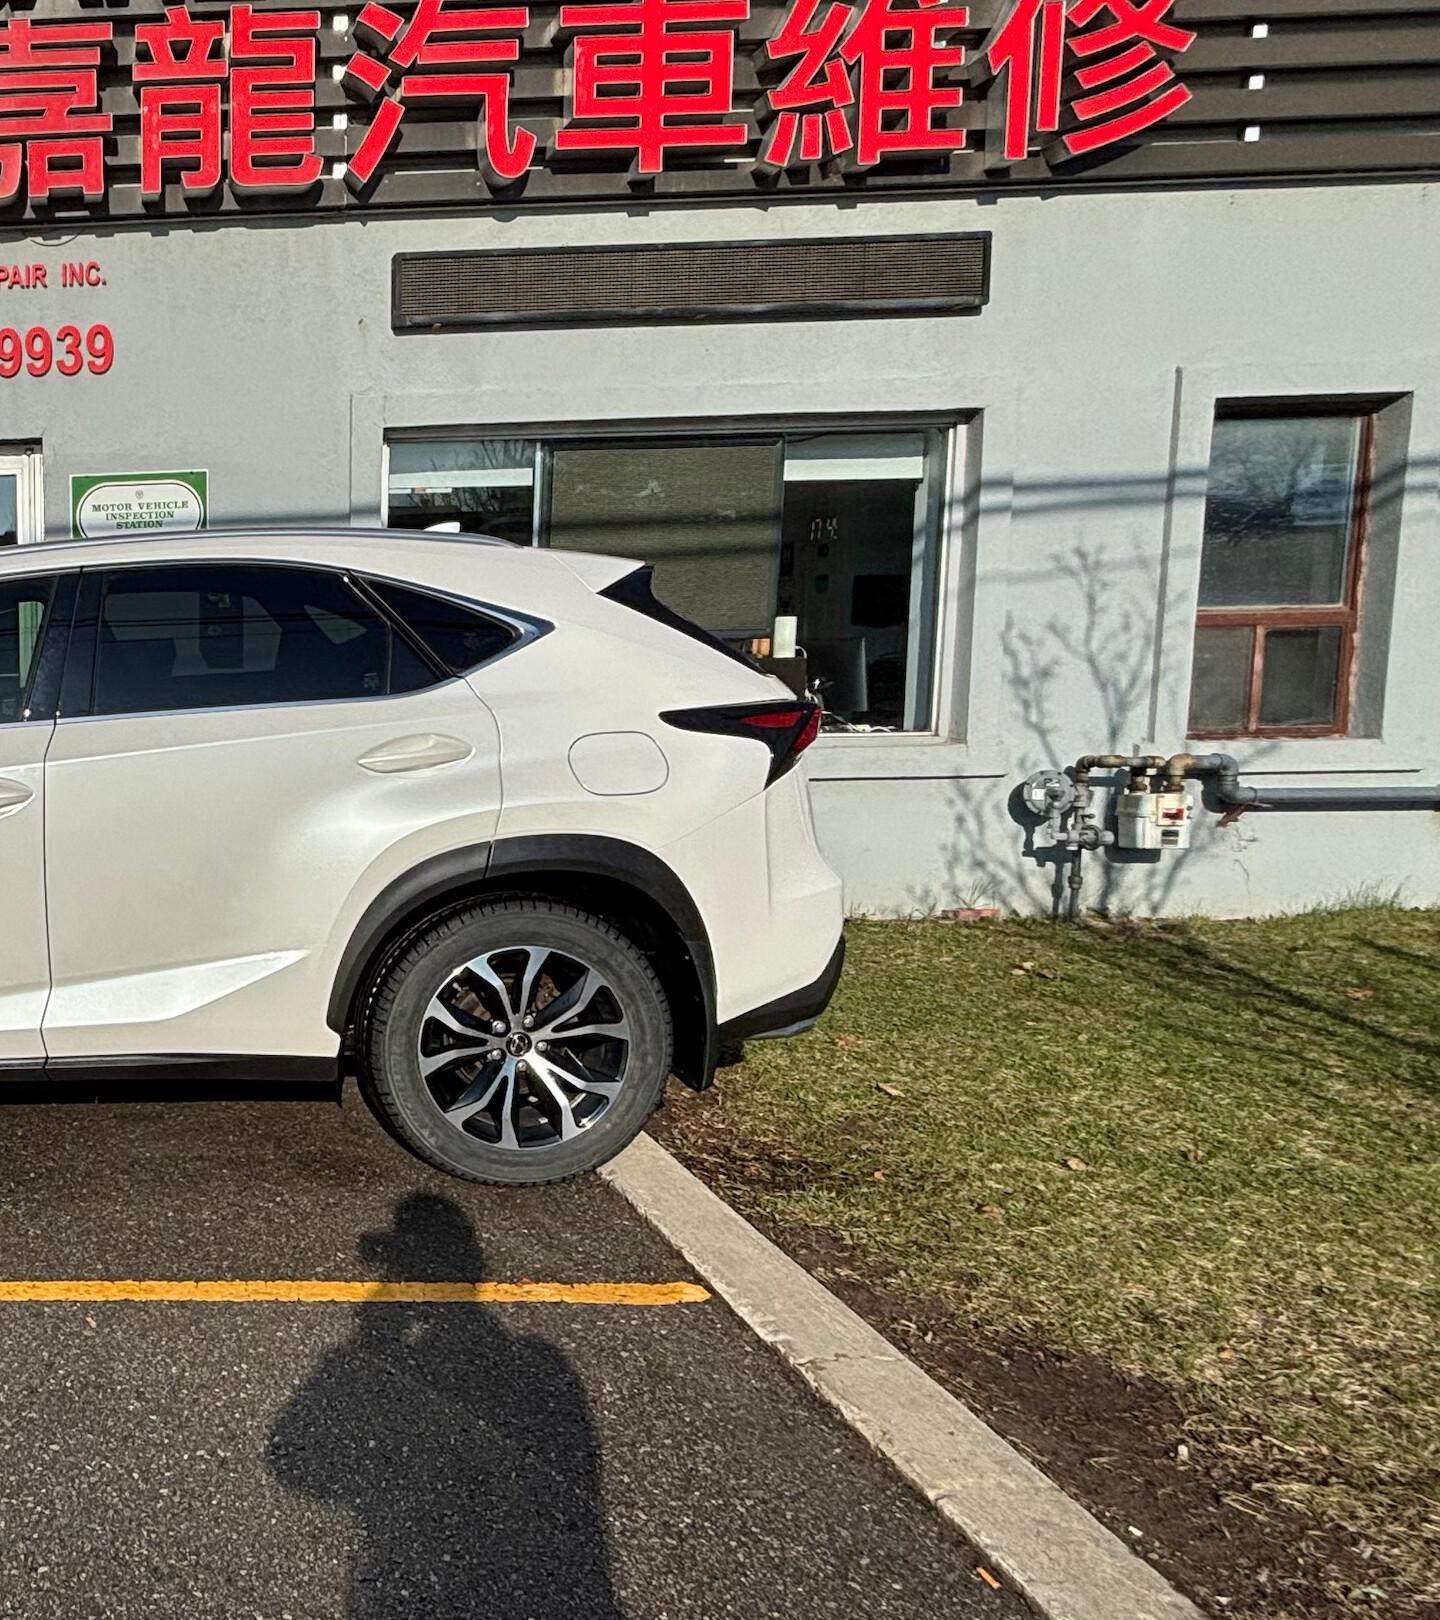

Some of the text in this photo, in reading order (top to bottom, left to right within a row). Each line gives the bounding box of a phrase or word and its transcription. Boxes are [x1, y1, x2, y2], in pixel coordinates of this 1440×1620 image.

[61, 261, 107, 287] INC.
[92, 501, 189, 512] MOTOR VEHICLE
[105, 511, 174, 521] INSPECTION
[116, 520, 163, 529] STATION
